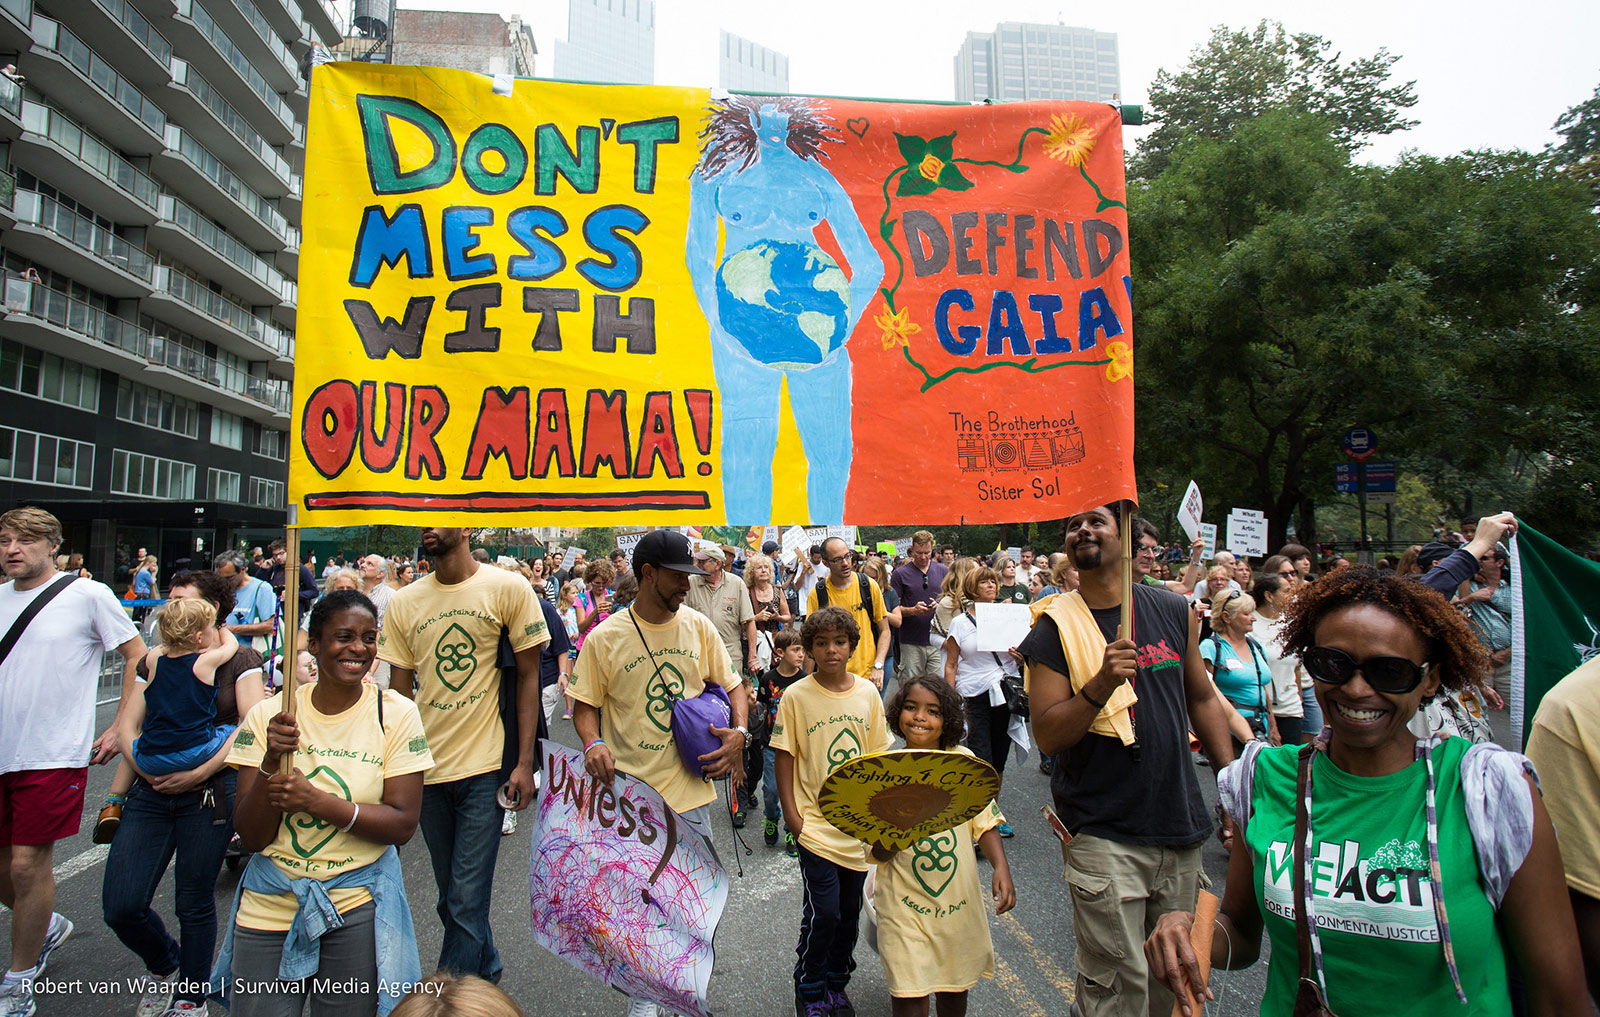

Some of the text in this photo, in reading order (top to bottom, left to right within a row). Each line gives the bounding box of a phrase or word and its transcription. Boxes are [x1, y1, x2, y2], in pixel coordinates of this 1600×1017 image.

[357, 93, 679, 196] DON'T
[349, 204, 651, 292] MESS
[902, 210, 1123, 281] DEFEND
[343, 282, 657, 359] WITH
[302, 379, 713, 480] OUR MAMA!
[948, 410, 1076, 432] The Brotherhood
[977, 476, 1061, 501] Sister Sol
[809, 529, 825, 537] SAV
[416, 608, 497, 635] Earth Sustains Life
[624, 655, 647, 673] Earth
[649, 647, 687, 660] Sustains
[428, 688, 488, 711] Asase Ye Duru
[307, 744, 358, 759] Sustains
[637, 740, 665, 752] Asase
[919, 768, 934, 782] 4
[967, 780, 984, 788] is
[327, 856, 354, 871] Duru
[1333, 865, 1430, 907] ACT
[901, 895, 967, 919] Asase Ye Duru
[1265, 898, 1439, 942] FOR ENONMENTAL JUSTICE
